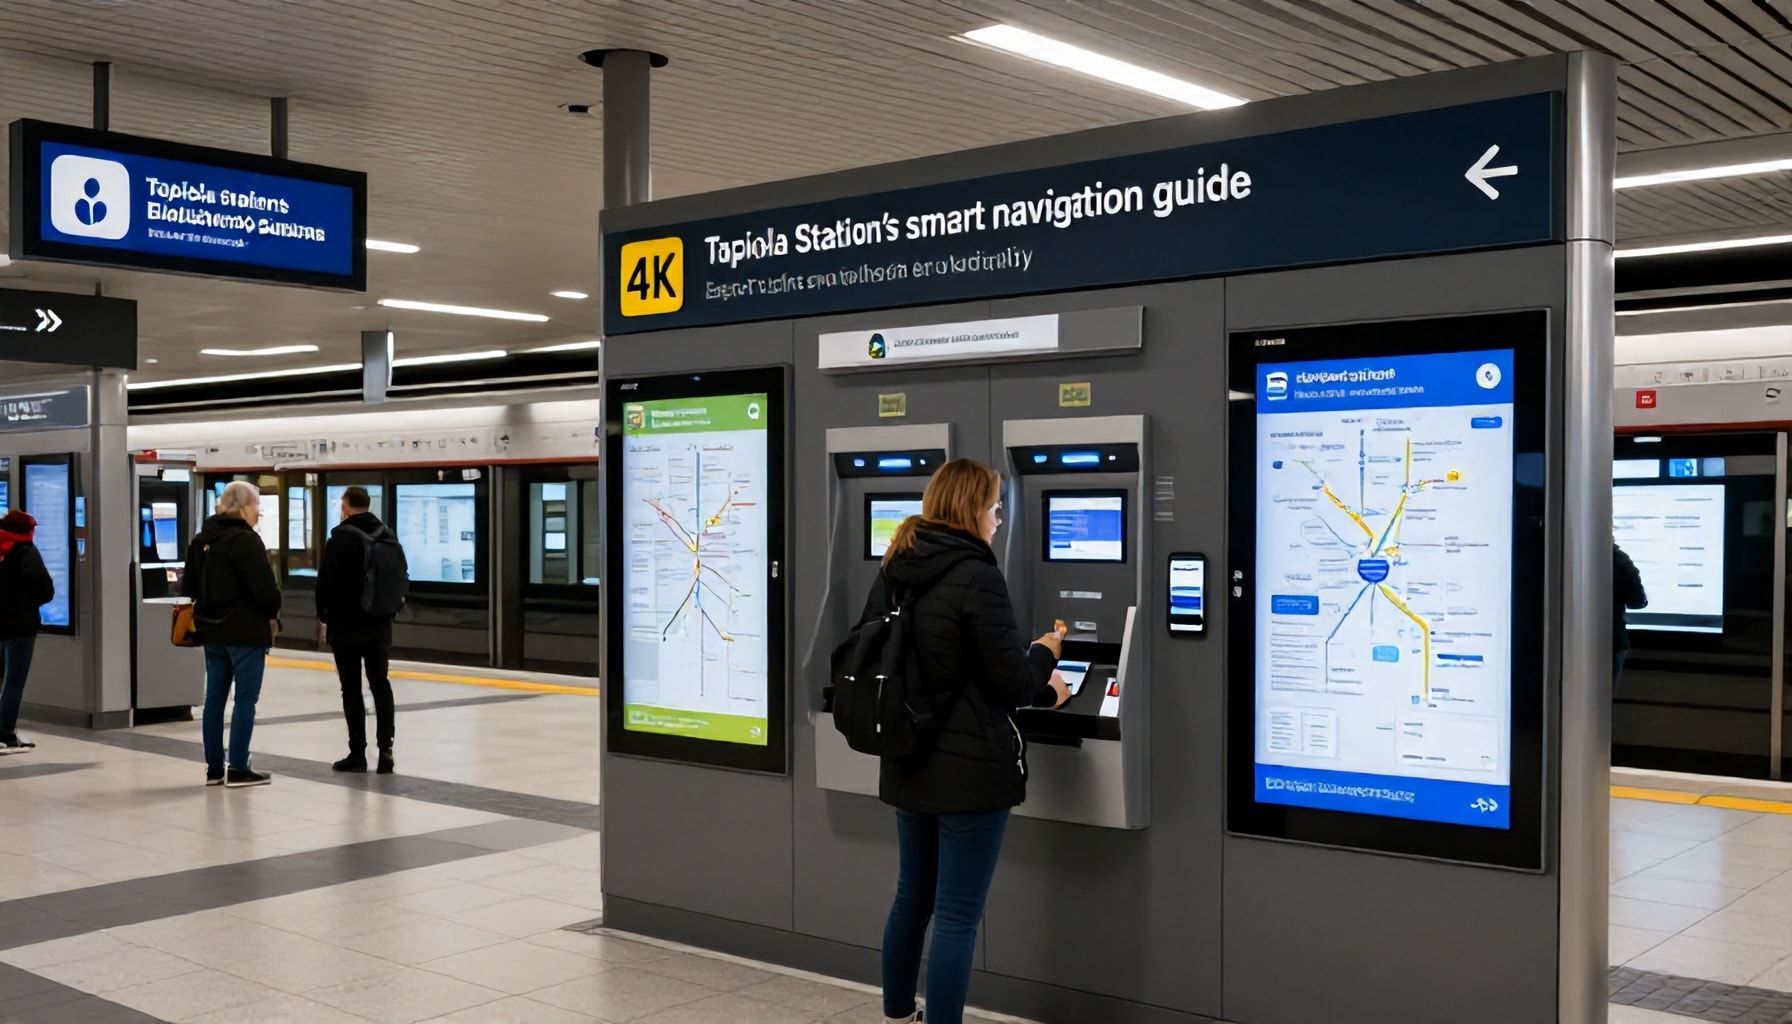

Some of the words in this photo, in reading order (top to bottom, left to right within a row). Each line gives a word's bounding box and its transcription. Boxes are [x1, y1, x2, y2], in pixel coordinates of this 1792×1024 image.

[794, 212, 899, 253] Station's
[905, 200, 985, 239] smart
[993, 182, 1143, 229] navigation
[1152, 163, 1252, 218] guide
[627, 252, 676, 300] 4K
